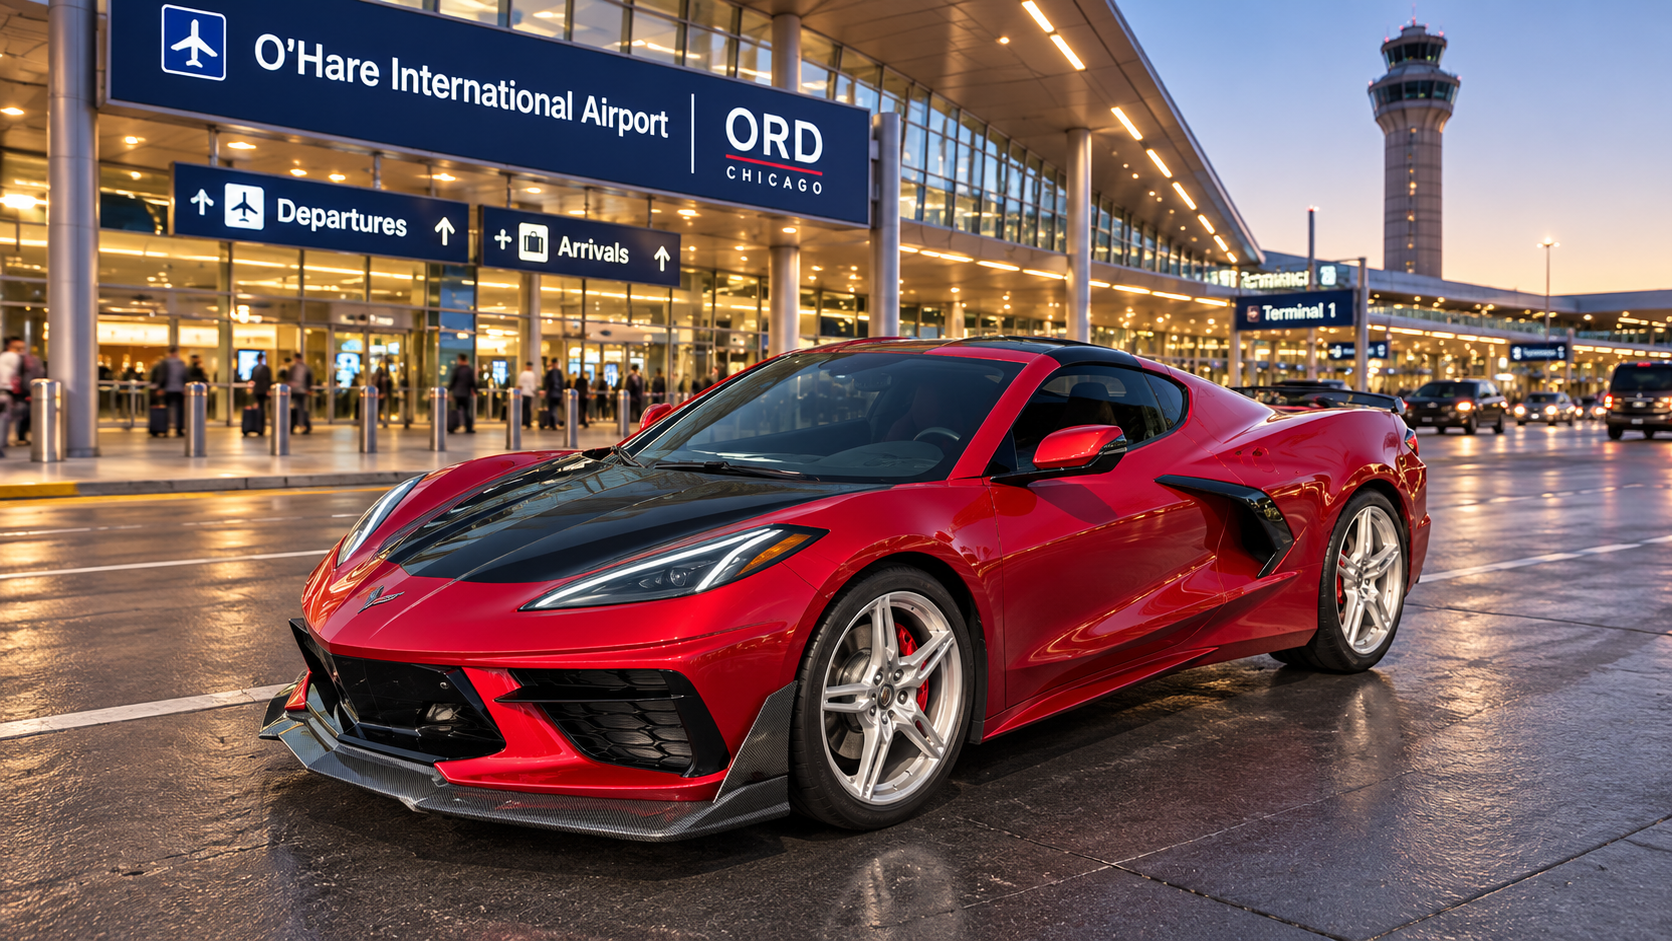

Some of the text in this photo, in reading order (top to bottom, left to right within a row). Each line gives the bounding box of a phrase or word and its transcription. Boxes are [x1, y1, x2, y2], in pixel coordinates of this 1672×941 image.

[254, 33, 669, 139] O'Hare International Airport
[725, 107, 823, 164] ORD
[726, 165, 823, 195] CHICAGO
[277, 197, 407, 237] Departures
[557, 235, 629, 265] Arrivals
[1262, 302, 1336, 321] Terminal 1
